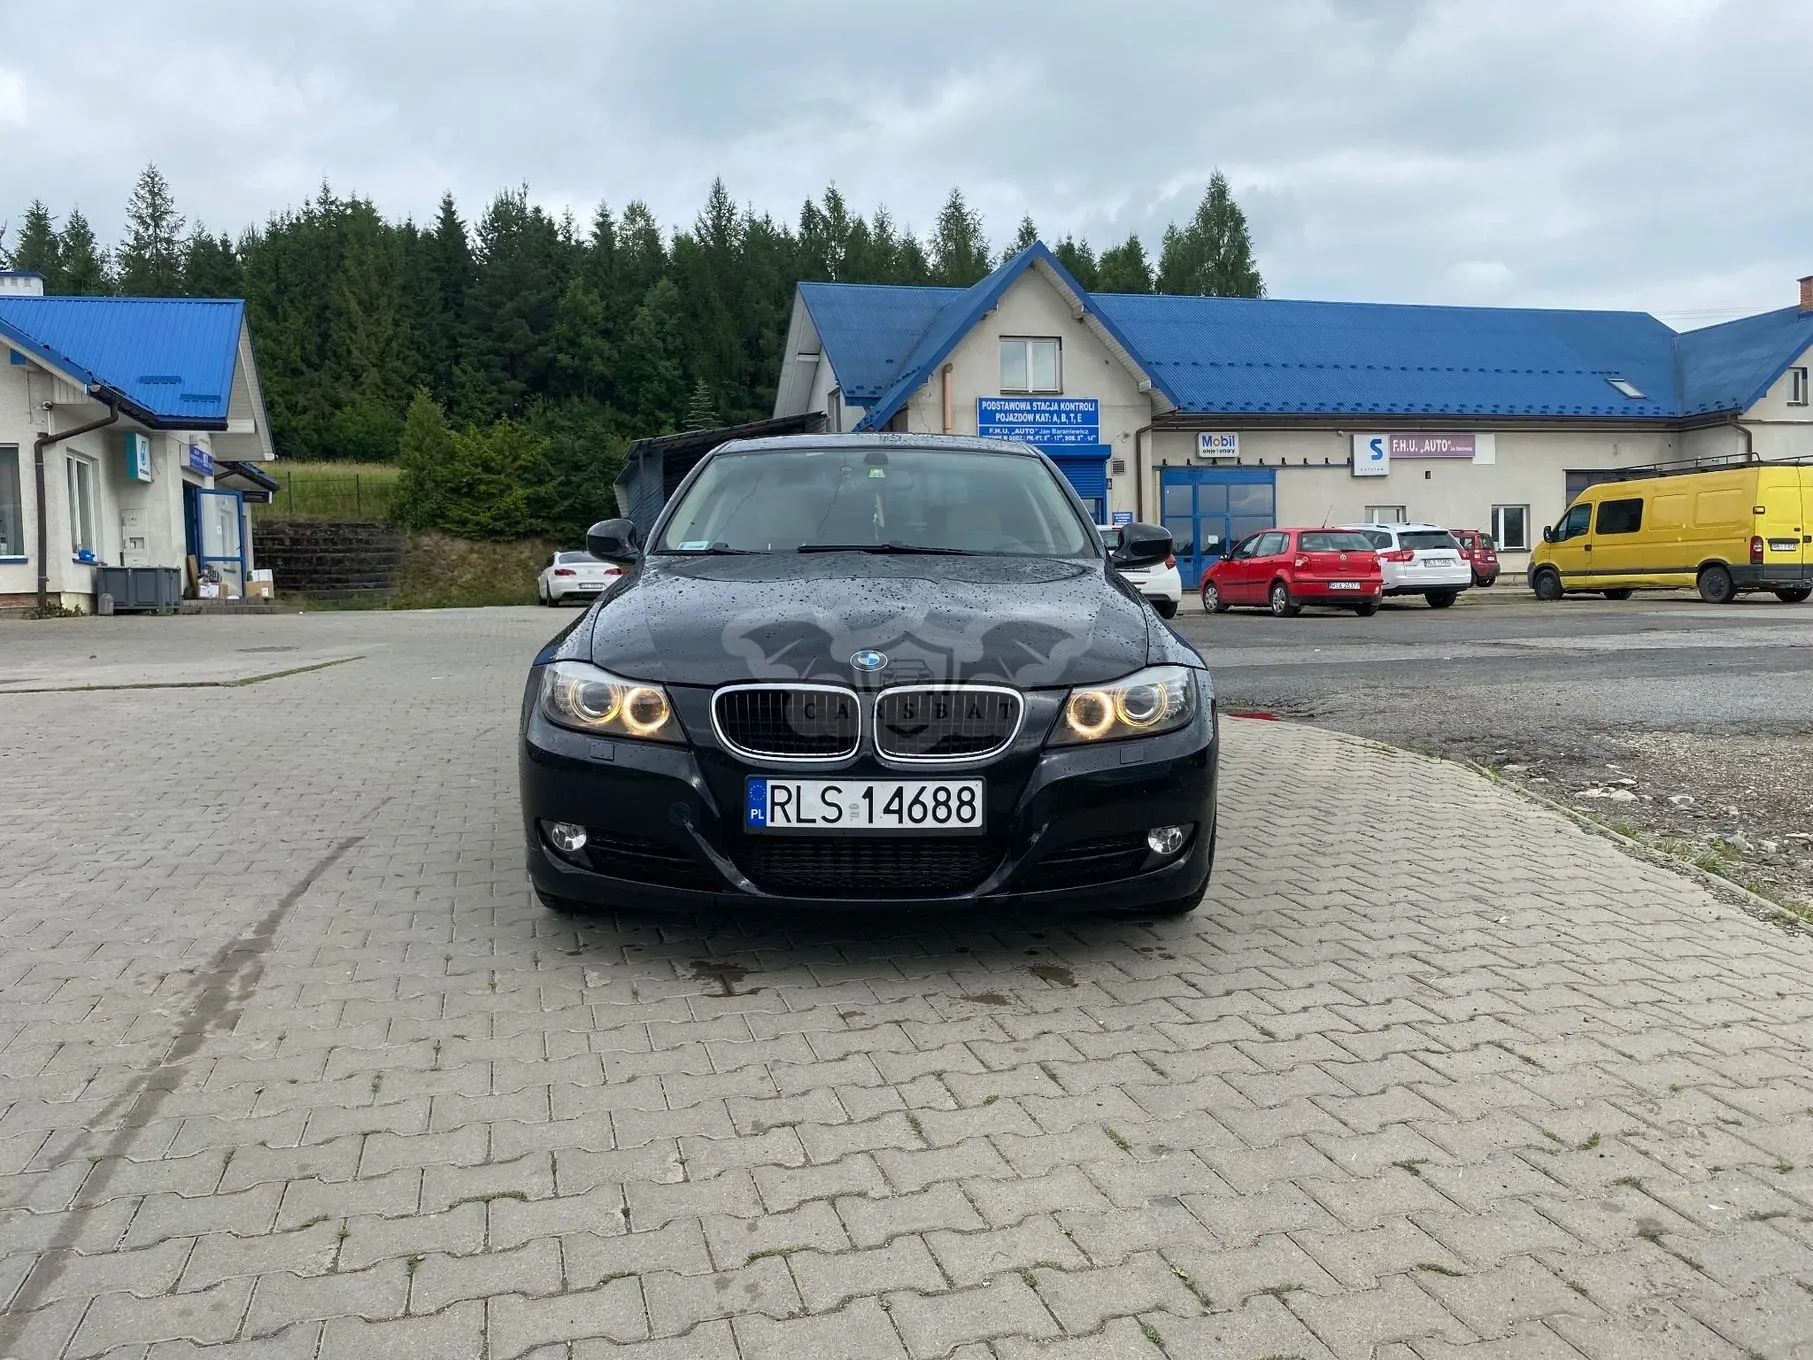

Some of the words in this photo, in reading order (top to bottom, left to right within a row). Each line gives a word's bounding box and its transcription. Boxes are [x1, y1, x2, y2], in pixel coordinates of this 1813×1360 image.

[982, 401, 1031, 411] PODSTAWOWA
[1032, 402, 1059, 411] STACJA
[1060, 402, 1095, 412] KONTROLI
[995, 411, 1035, 422] POJAZDÓW
[1035, 413, 1051, 423] KAT:
[1202, 435, 1235, 447] Mobil
[1393, 440, 1418, 453] F.H.U.
[770, 784, 843, 824] RLS
[862, 785, 977, 825] 14688
[750, 808, 764, 820] PL
